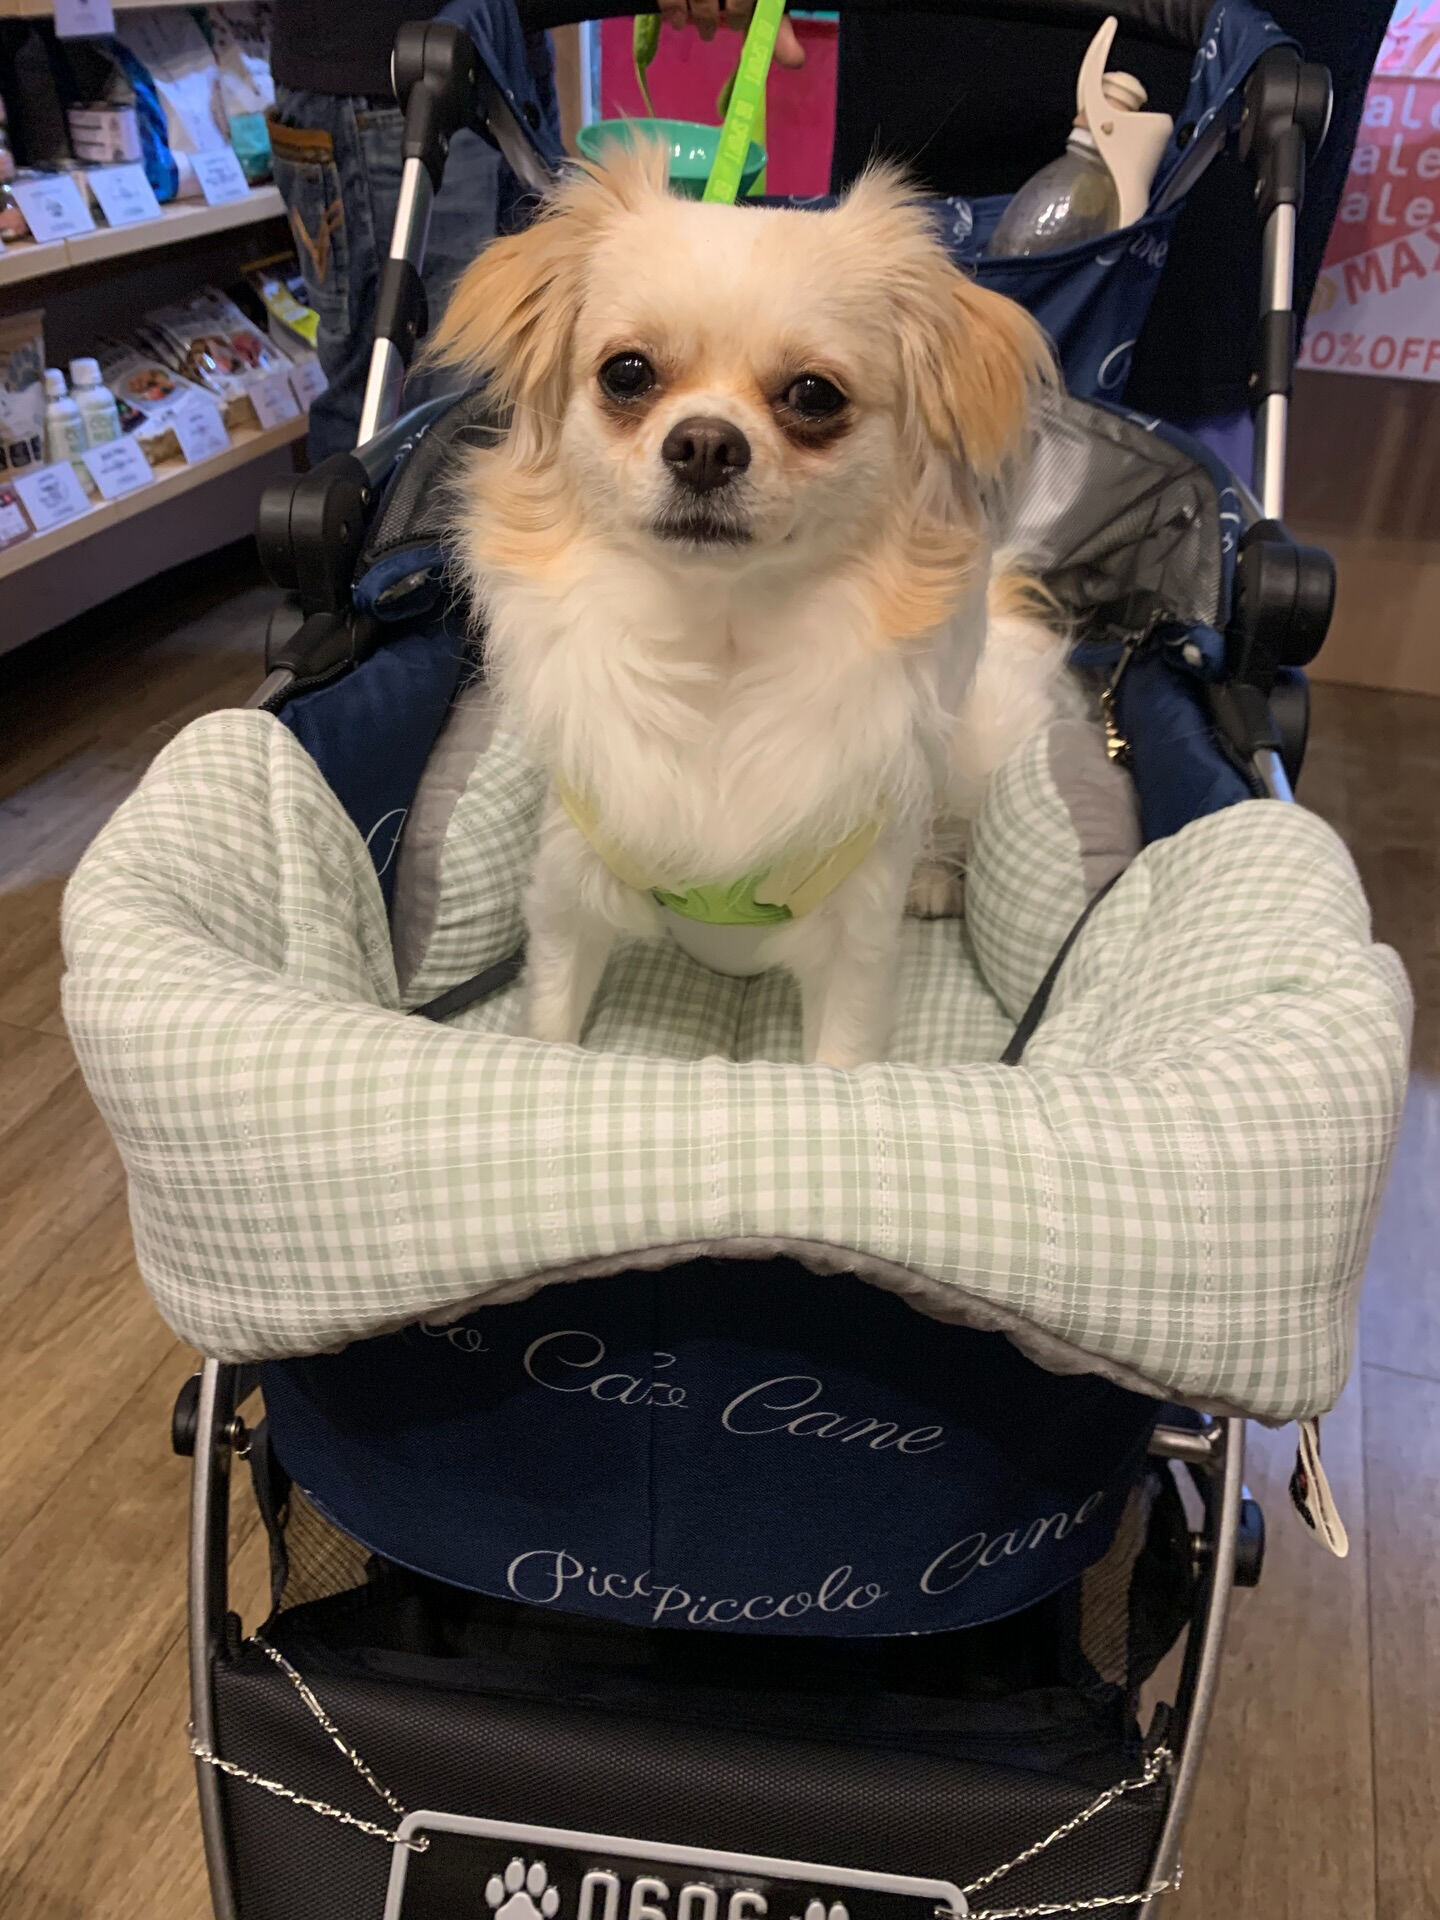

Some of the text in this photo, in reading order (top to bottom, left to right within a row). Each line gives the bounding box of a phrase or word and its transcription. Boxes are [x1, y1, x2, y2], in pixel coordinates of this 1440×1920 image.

[1351, 132, 1440, 179] ale
[1340, 182, 1434, 227] ale
[721, 1375, 946, 1455] Cane
[651, 1565, 889, 1624] Piccolo
